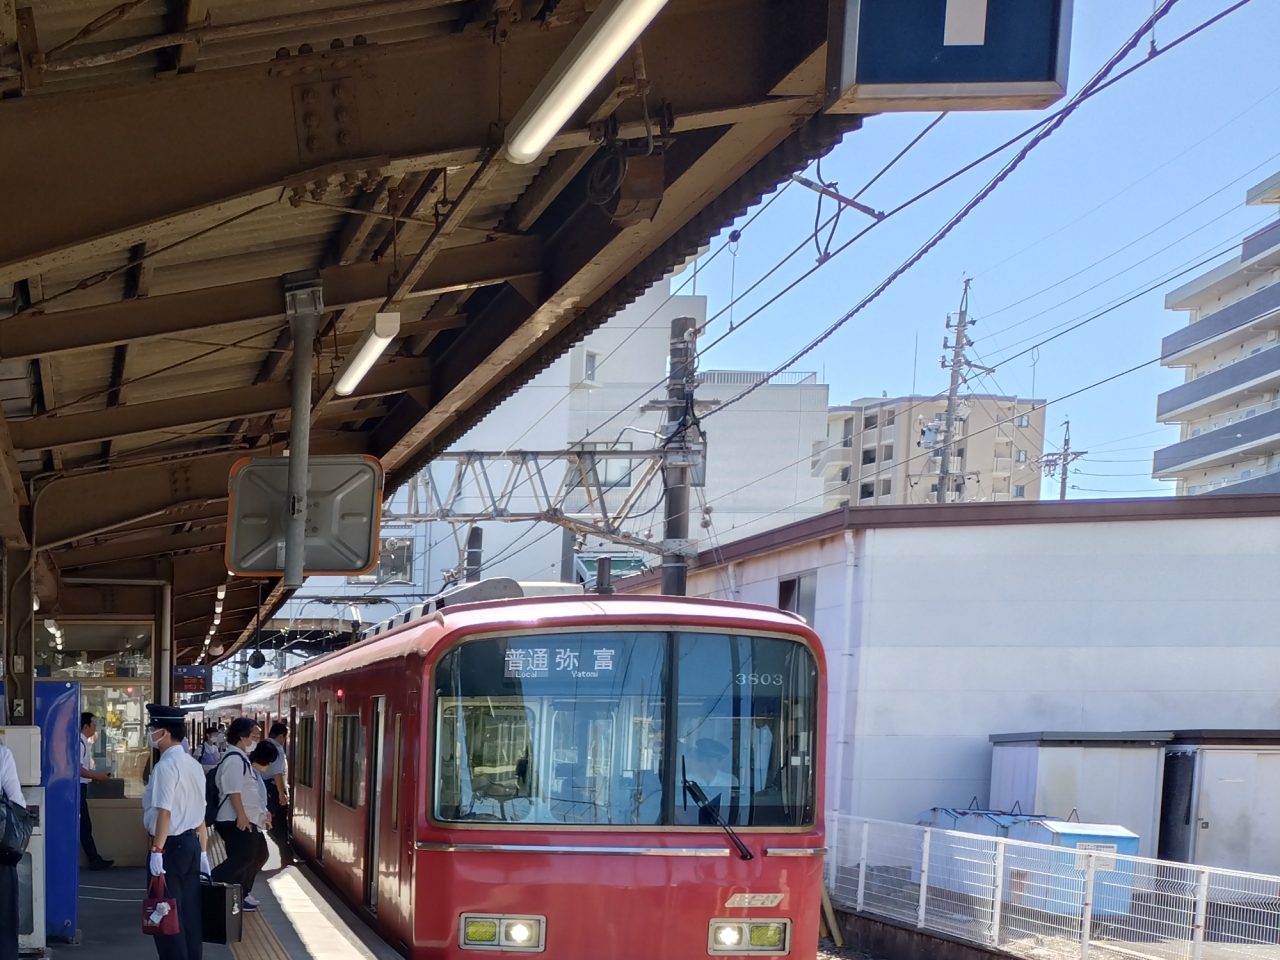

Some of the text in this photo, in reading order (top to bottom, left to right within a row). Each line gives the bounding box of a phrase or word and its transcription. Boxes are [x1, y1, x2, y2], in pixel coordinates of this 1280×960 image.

[504, 648, 615, 671] 普通 弥富
[571, 670, 599, 678] Yatomi
[735, 673, 783, 686] 3803
